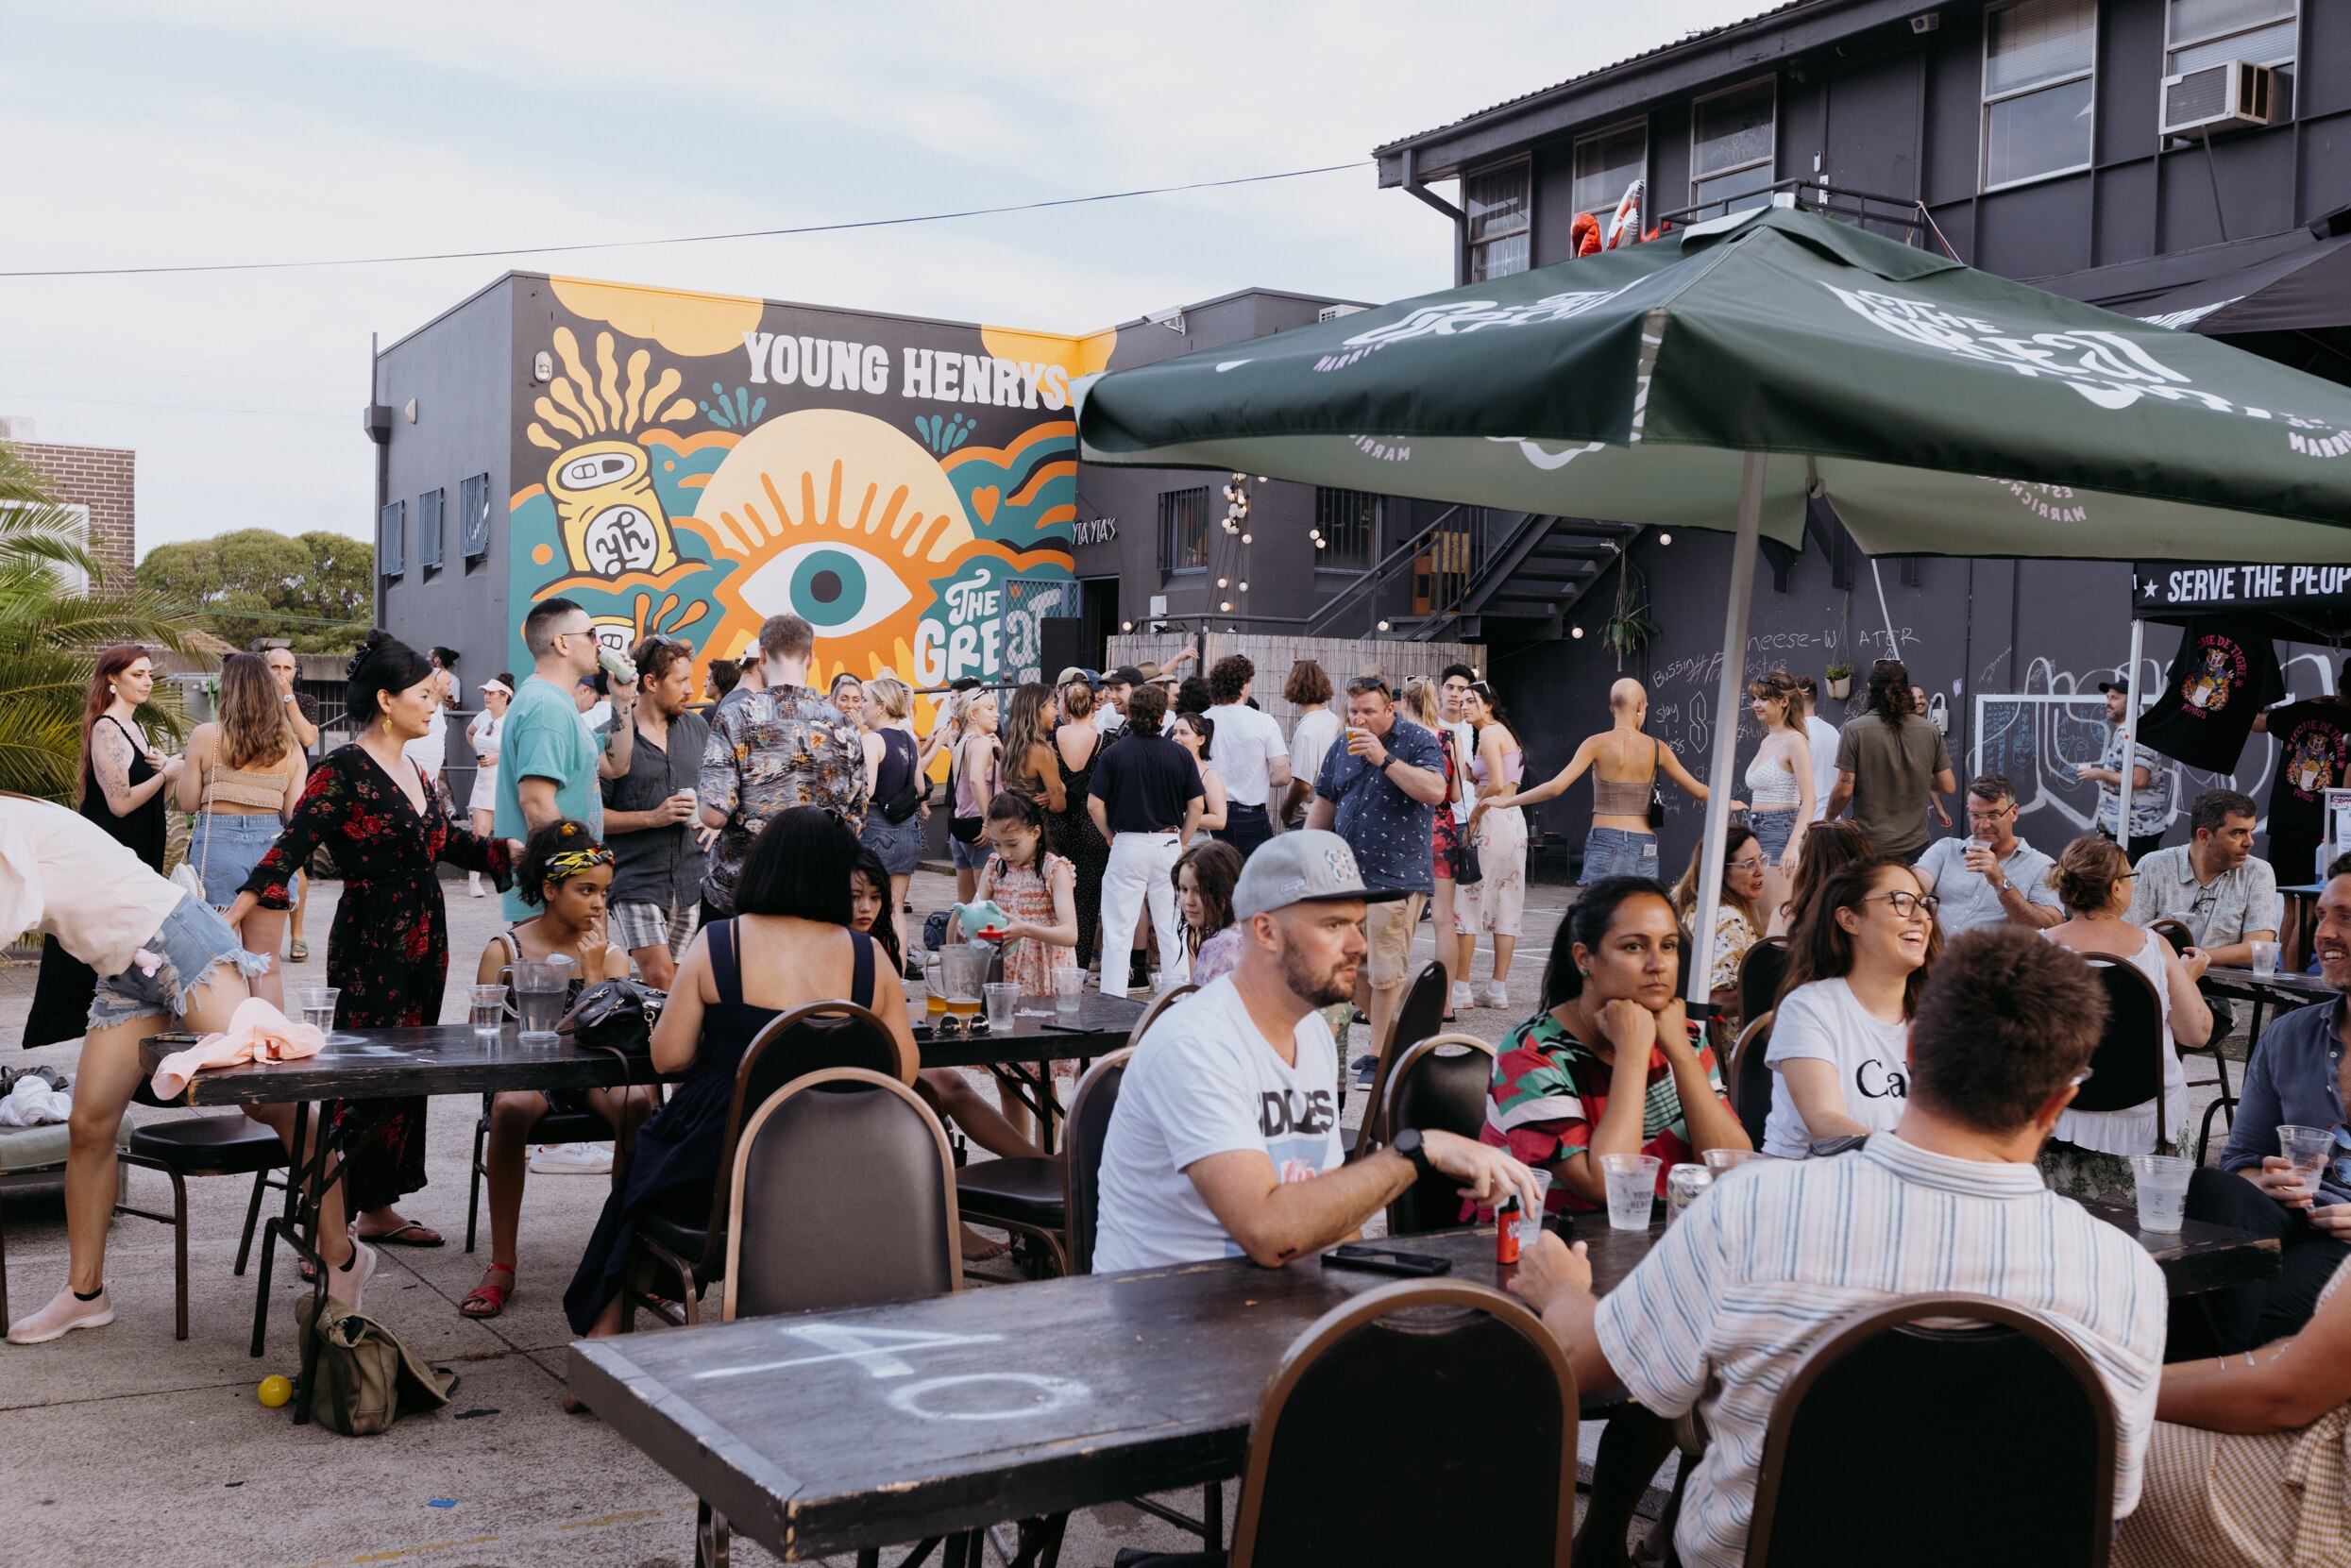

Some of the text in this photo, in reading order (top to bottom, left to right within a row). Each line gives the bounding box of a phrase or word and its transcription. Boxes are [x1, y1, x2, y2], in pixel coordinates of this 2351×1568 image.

[742, 331, 1069, 411] YOUNG HENRYS
[944, 568, 1001, 626] THE
[2167, 567, 2236, 603] SERVE
[2241, 565, 2285, 599] THE
[2216, 634, 2232, 649] DE
[2230, 644, 2247, 678] TIGRE
[2181, 702, 2207, 719] PEPITOS
[2319, 721, 2333, 733] DE
